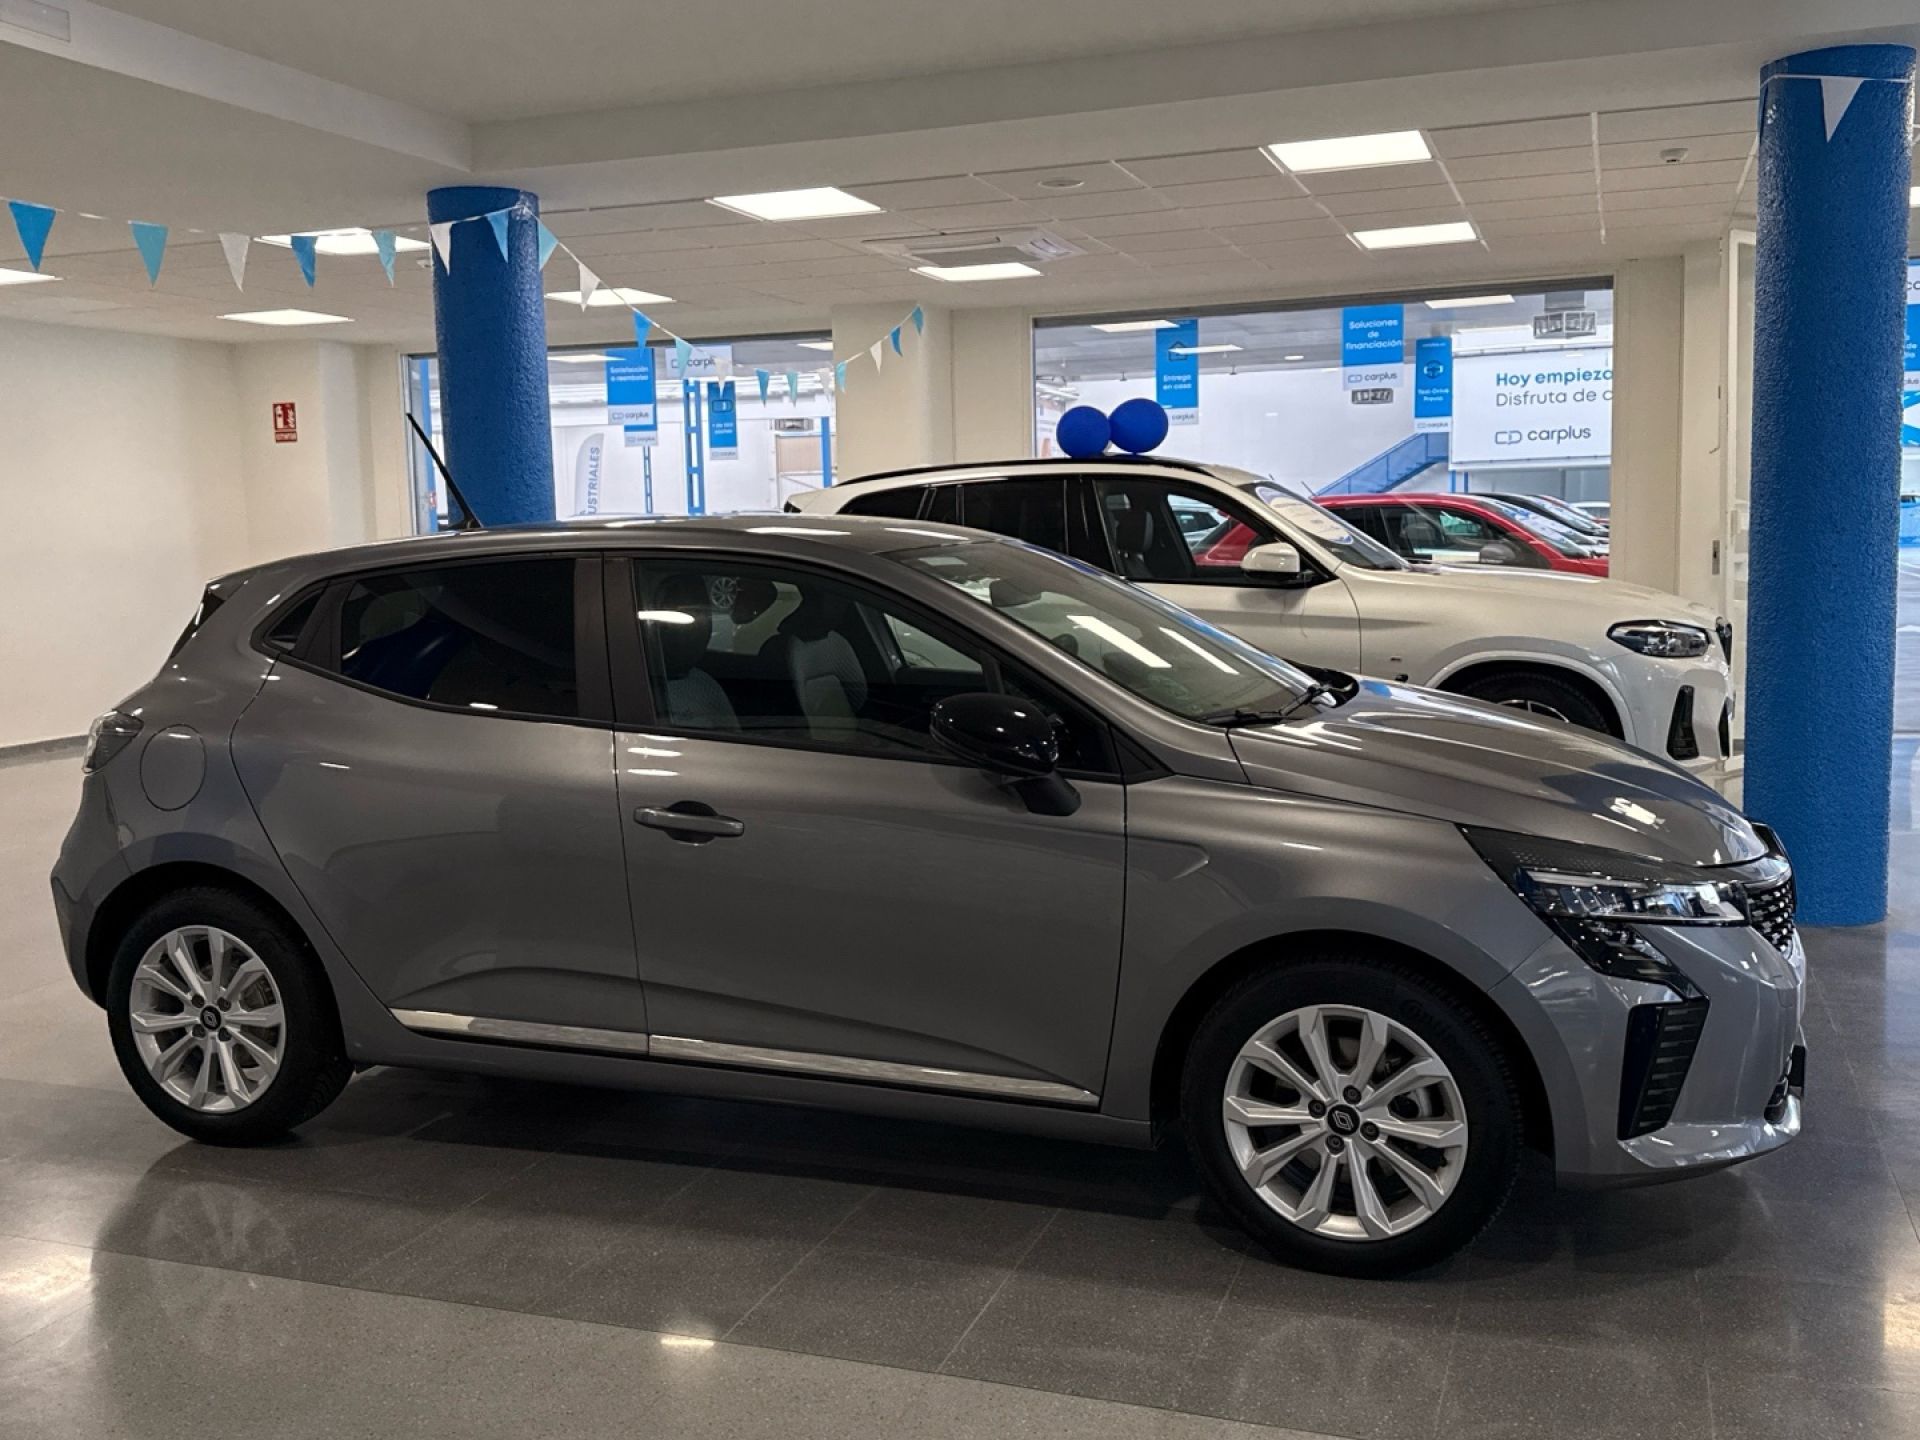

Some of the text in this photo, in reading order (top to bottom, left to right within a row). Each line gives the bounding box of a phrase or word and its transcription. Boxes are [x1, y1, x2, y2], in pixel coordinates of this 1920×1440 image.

[1348, 319, 1399, 331] Soluciones
[1367, 331, 1380, 339] de
[1345, 339, 1402, 350] financiación
[1363, 371, 1398, 383] carplus
[1495, 372, 1532, 388] Hoy
[1495, 390, 1568, 407] Disfruta
[1572, 388, 1597, 403] de
[624, 409, 650, 420] carplus
[1171, 412, 1195, 422] carplus
[1526, 425, 1592, 445] carplus
[587, 447, 600, 514] USTRIALES
